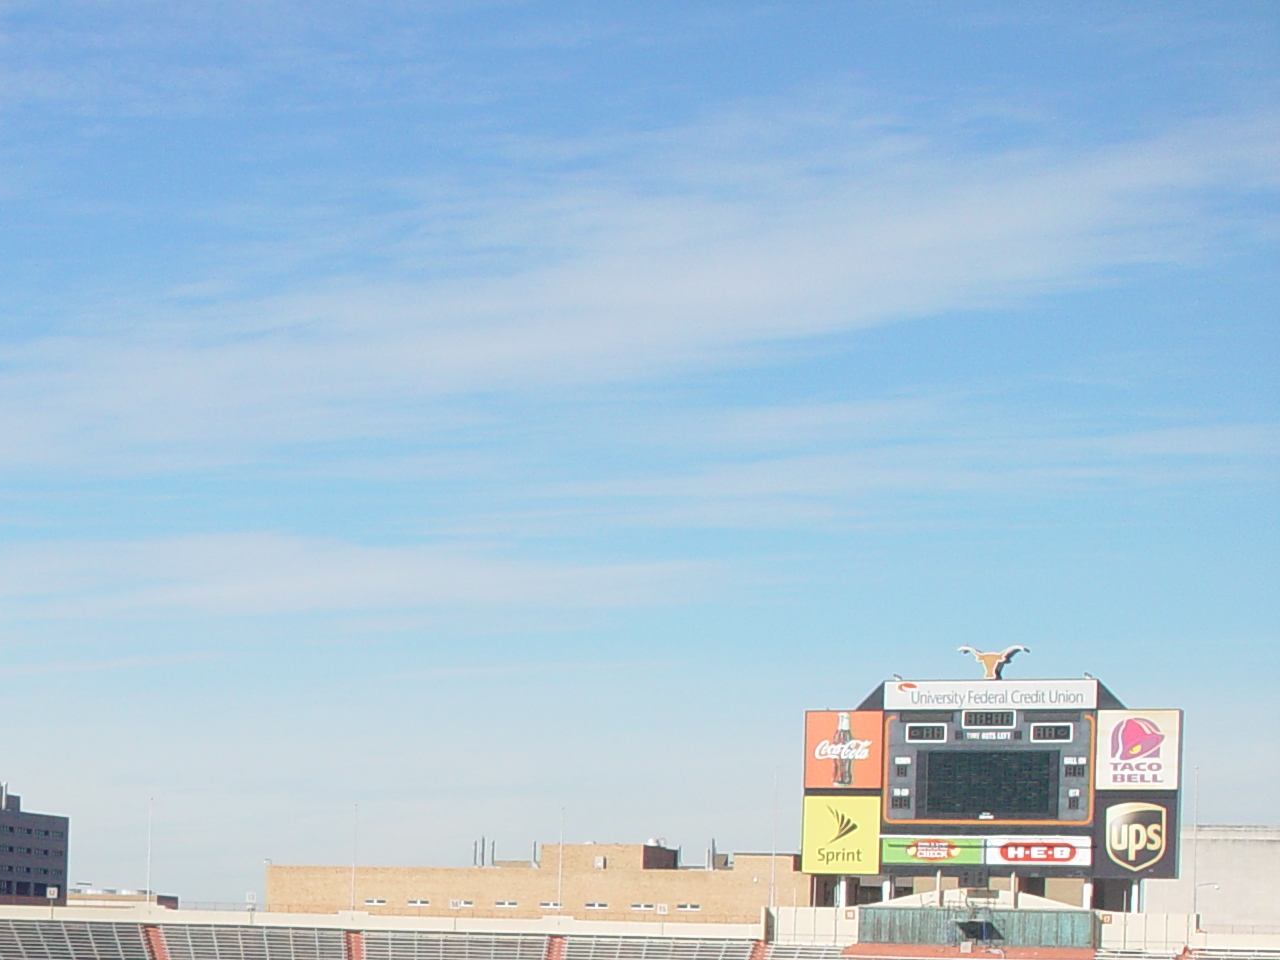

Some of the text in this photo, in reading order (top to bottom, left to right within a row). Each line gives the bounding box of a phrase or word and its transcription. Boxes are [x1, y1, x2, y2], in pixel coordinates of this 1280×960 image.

[911, 690, 1083, 707] University Federal Credit Union
[815, 740, 872, 760] Coca-Cola
[1109, 762, 1162, 771] TACO
[1112, 773, 1163, 783] BELL
[1111, 823, 1161, 861] ups
[817, 848, 862, 865] Sprint
[916, 850, 948, 858] CHECK
